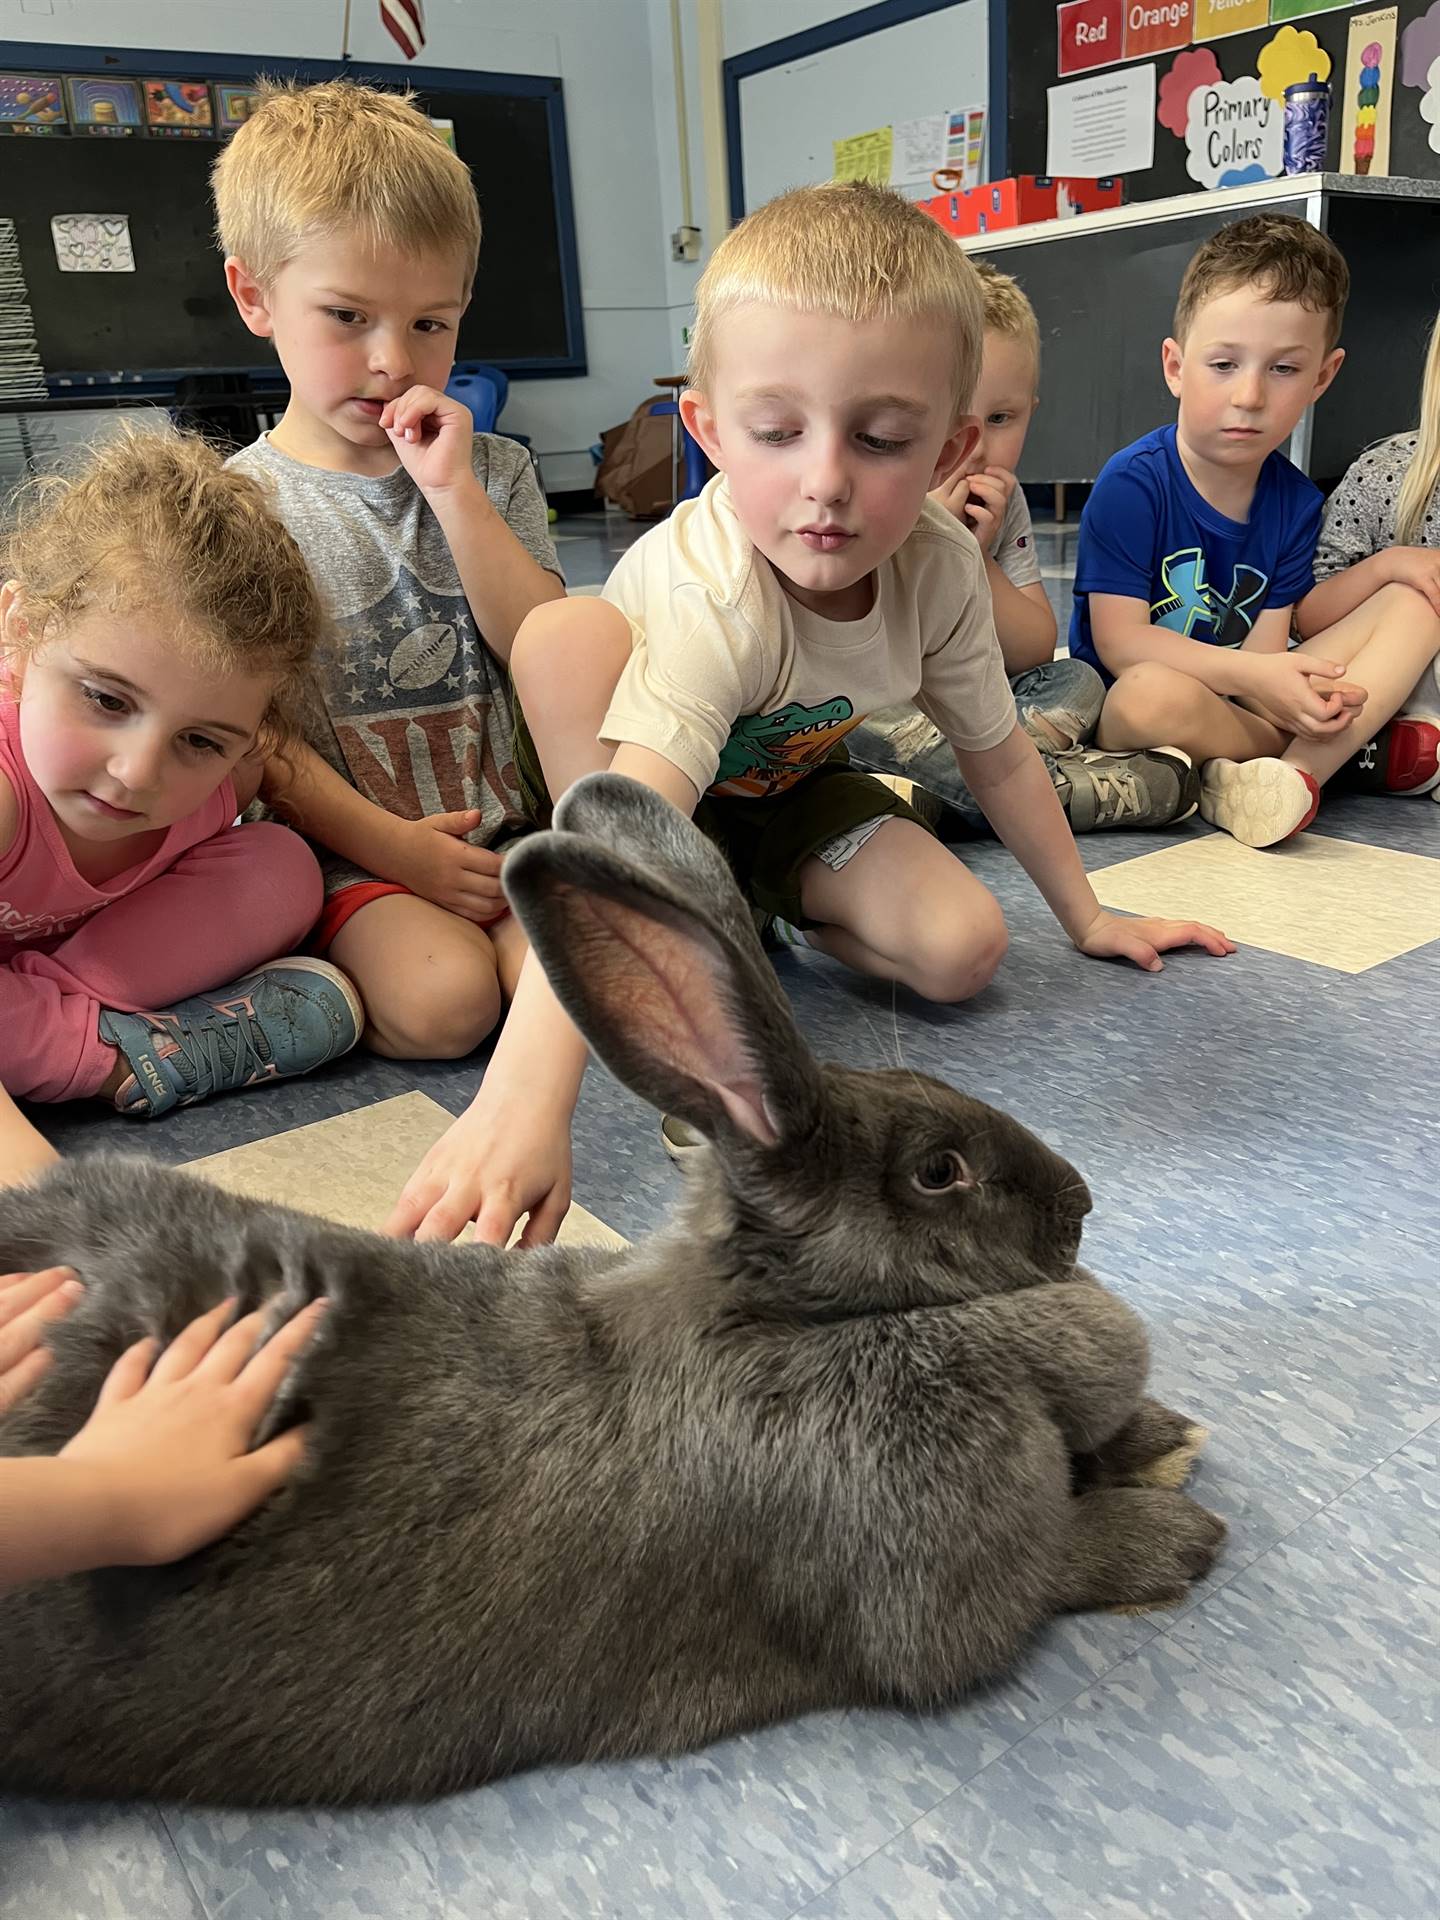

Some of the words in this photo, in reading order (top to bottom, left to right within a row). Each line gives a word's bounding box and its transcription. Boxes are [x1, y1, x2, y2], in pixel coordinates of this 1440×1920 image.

[1129, 1, 1189, 30] Orange
[1208, 0, 1253, 15] Yeo
[1075, 16, 1108, 46] Red
[1204, 91, 1271, 128] Primary
[1208, 128, 1263, 168] Colors
